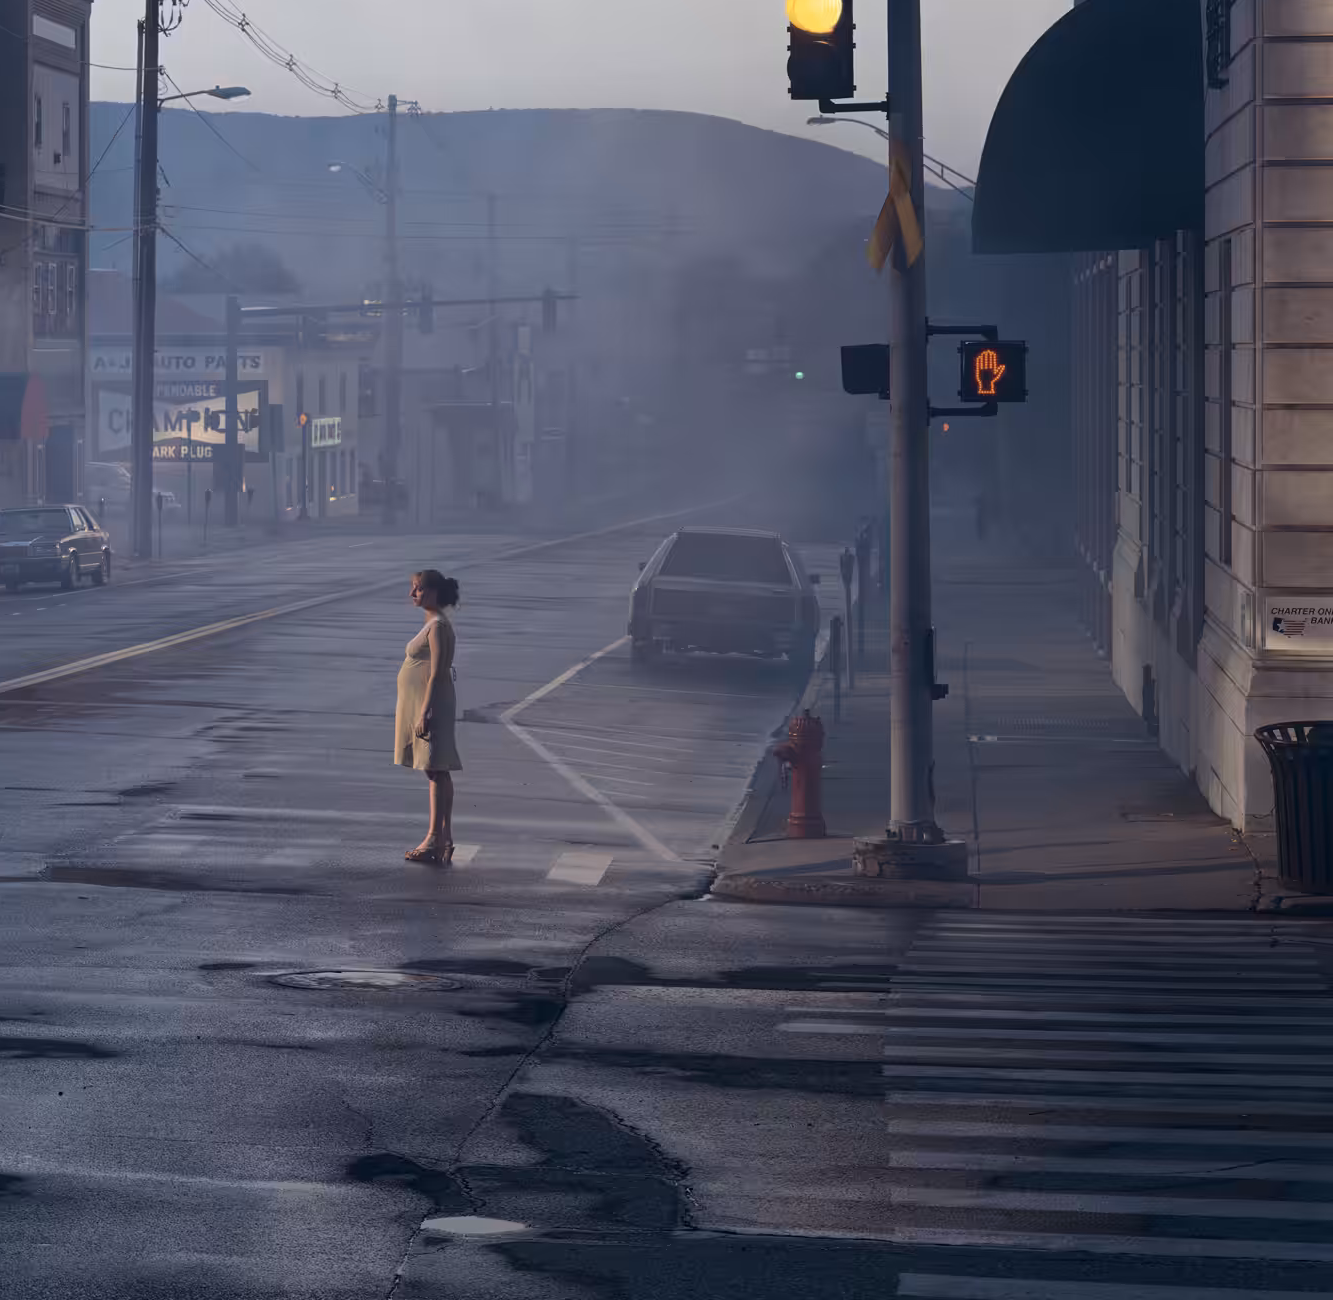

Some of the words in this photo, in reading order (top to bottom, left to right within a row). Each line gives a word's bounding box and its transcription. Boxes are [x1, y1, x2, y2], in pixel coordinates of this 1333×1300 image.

[204, 356, 262, 370] PATS
[152, 446, 175, 458] ARK
[1271, 607, 1316, 616] CHARTER
